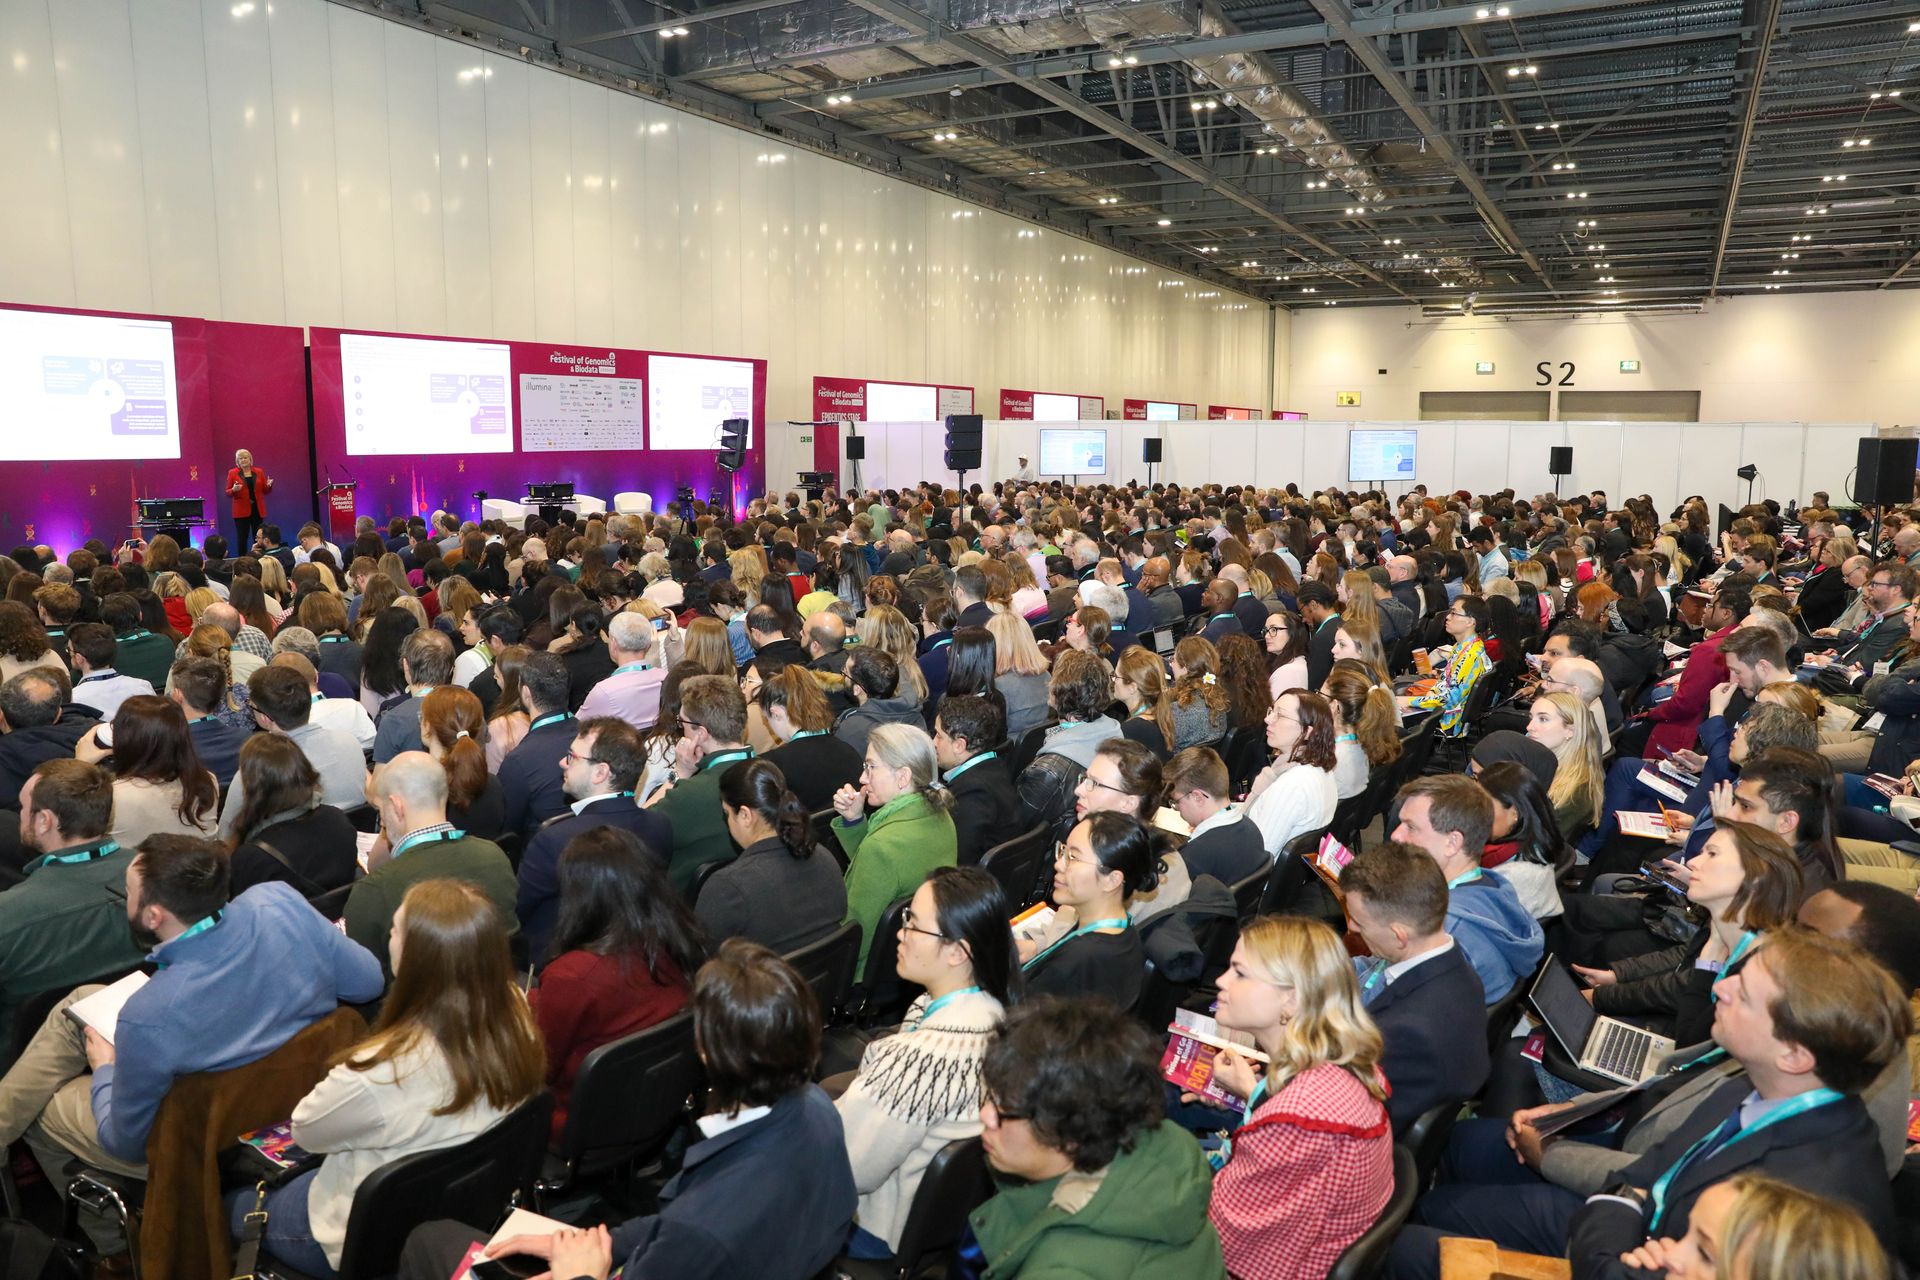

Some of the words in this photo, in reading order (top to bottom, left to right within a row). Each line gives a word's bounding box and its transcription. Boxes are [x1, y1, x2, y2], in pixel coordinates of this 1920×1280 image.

[550, 355, 576, 364] Festival
[577, 356, 584, 364] of
[585, 357, 616, 366] Genomics
[575, 365, 598, 373] Biodata
[1536, 361, 1576, 386] S2
[525, 382, 552, 391] illumina
[818, 390, 836, 398] Festival
[842, 391, 863, 399] Genomics
